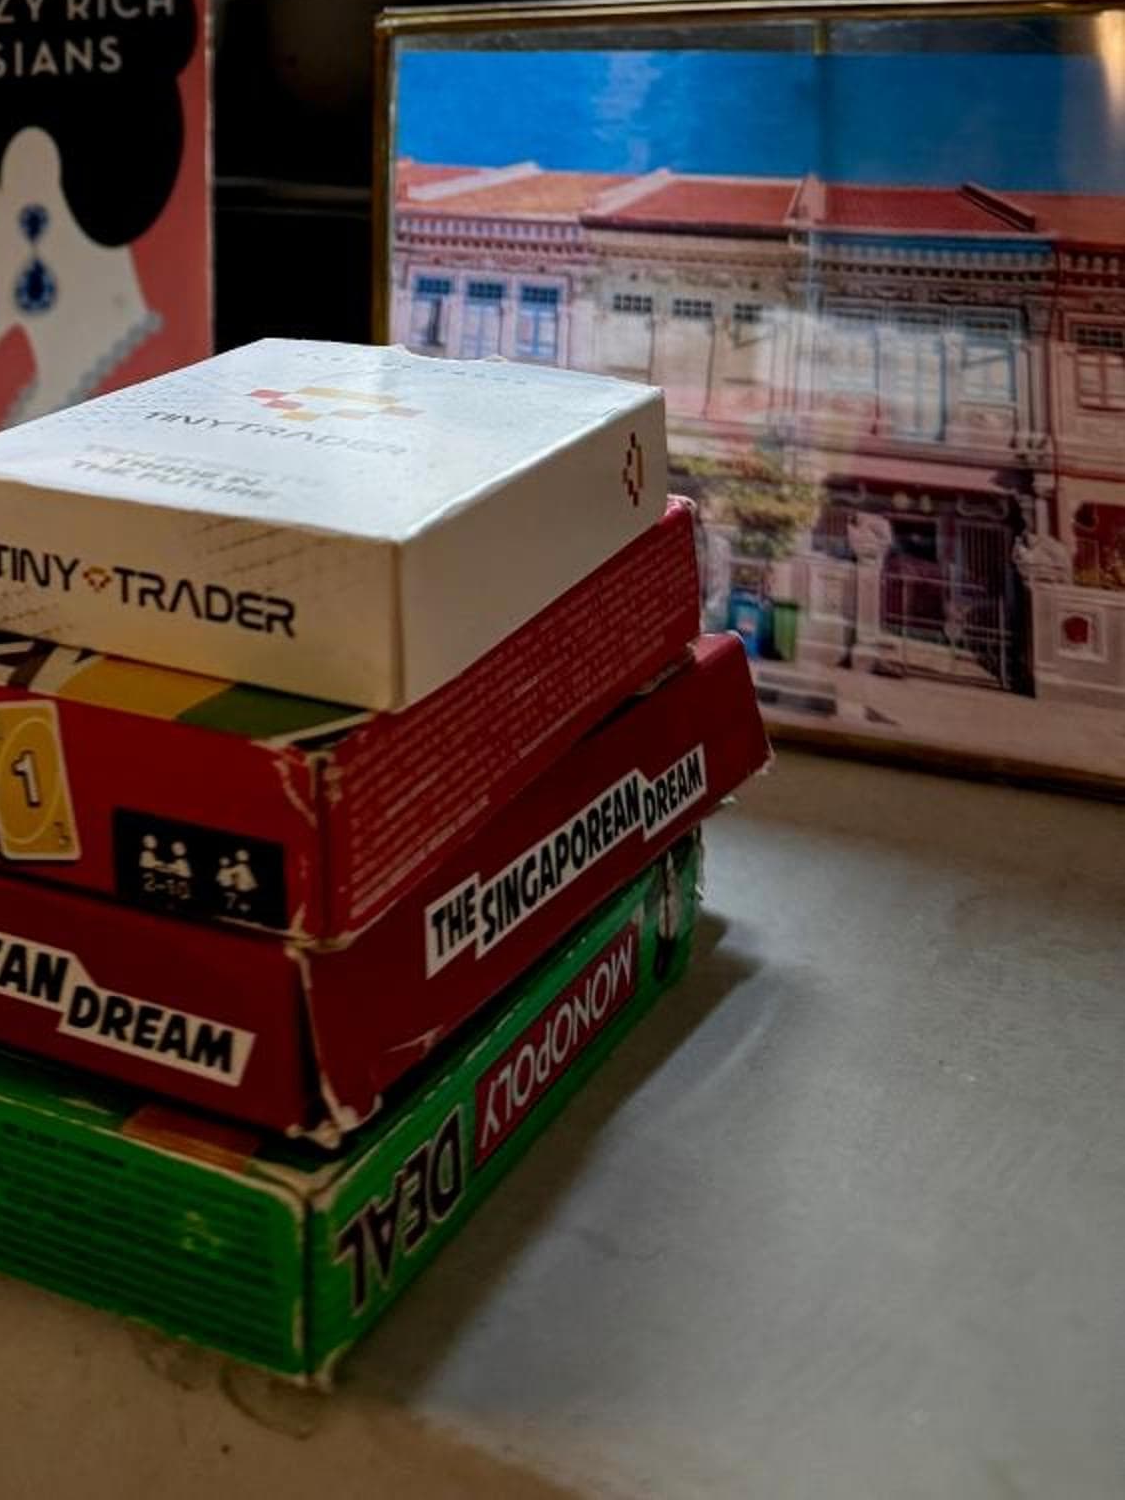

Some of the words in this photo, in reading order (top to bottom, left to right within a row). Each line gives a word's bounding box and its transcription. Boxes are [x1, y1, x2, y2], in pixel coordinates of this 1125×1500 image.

[111, 567, 297, 639] TRADER
[12, 750, 41, 807] 1
[431, 897, 479, 960] THE
[480, 775, 643, 948] SINGAPOREAN
[642, 752, 704, 830] DREAM
[66, 983, 236, 1076] DREAM
[479, 932, 635, 1150] MONOPOLY
[333, 1105, 466, 1317] DEAL
